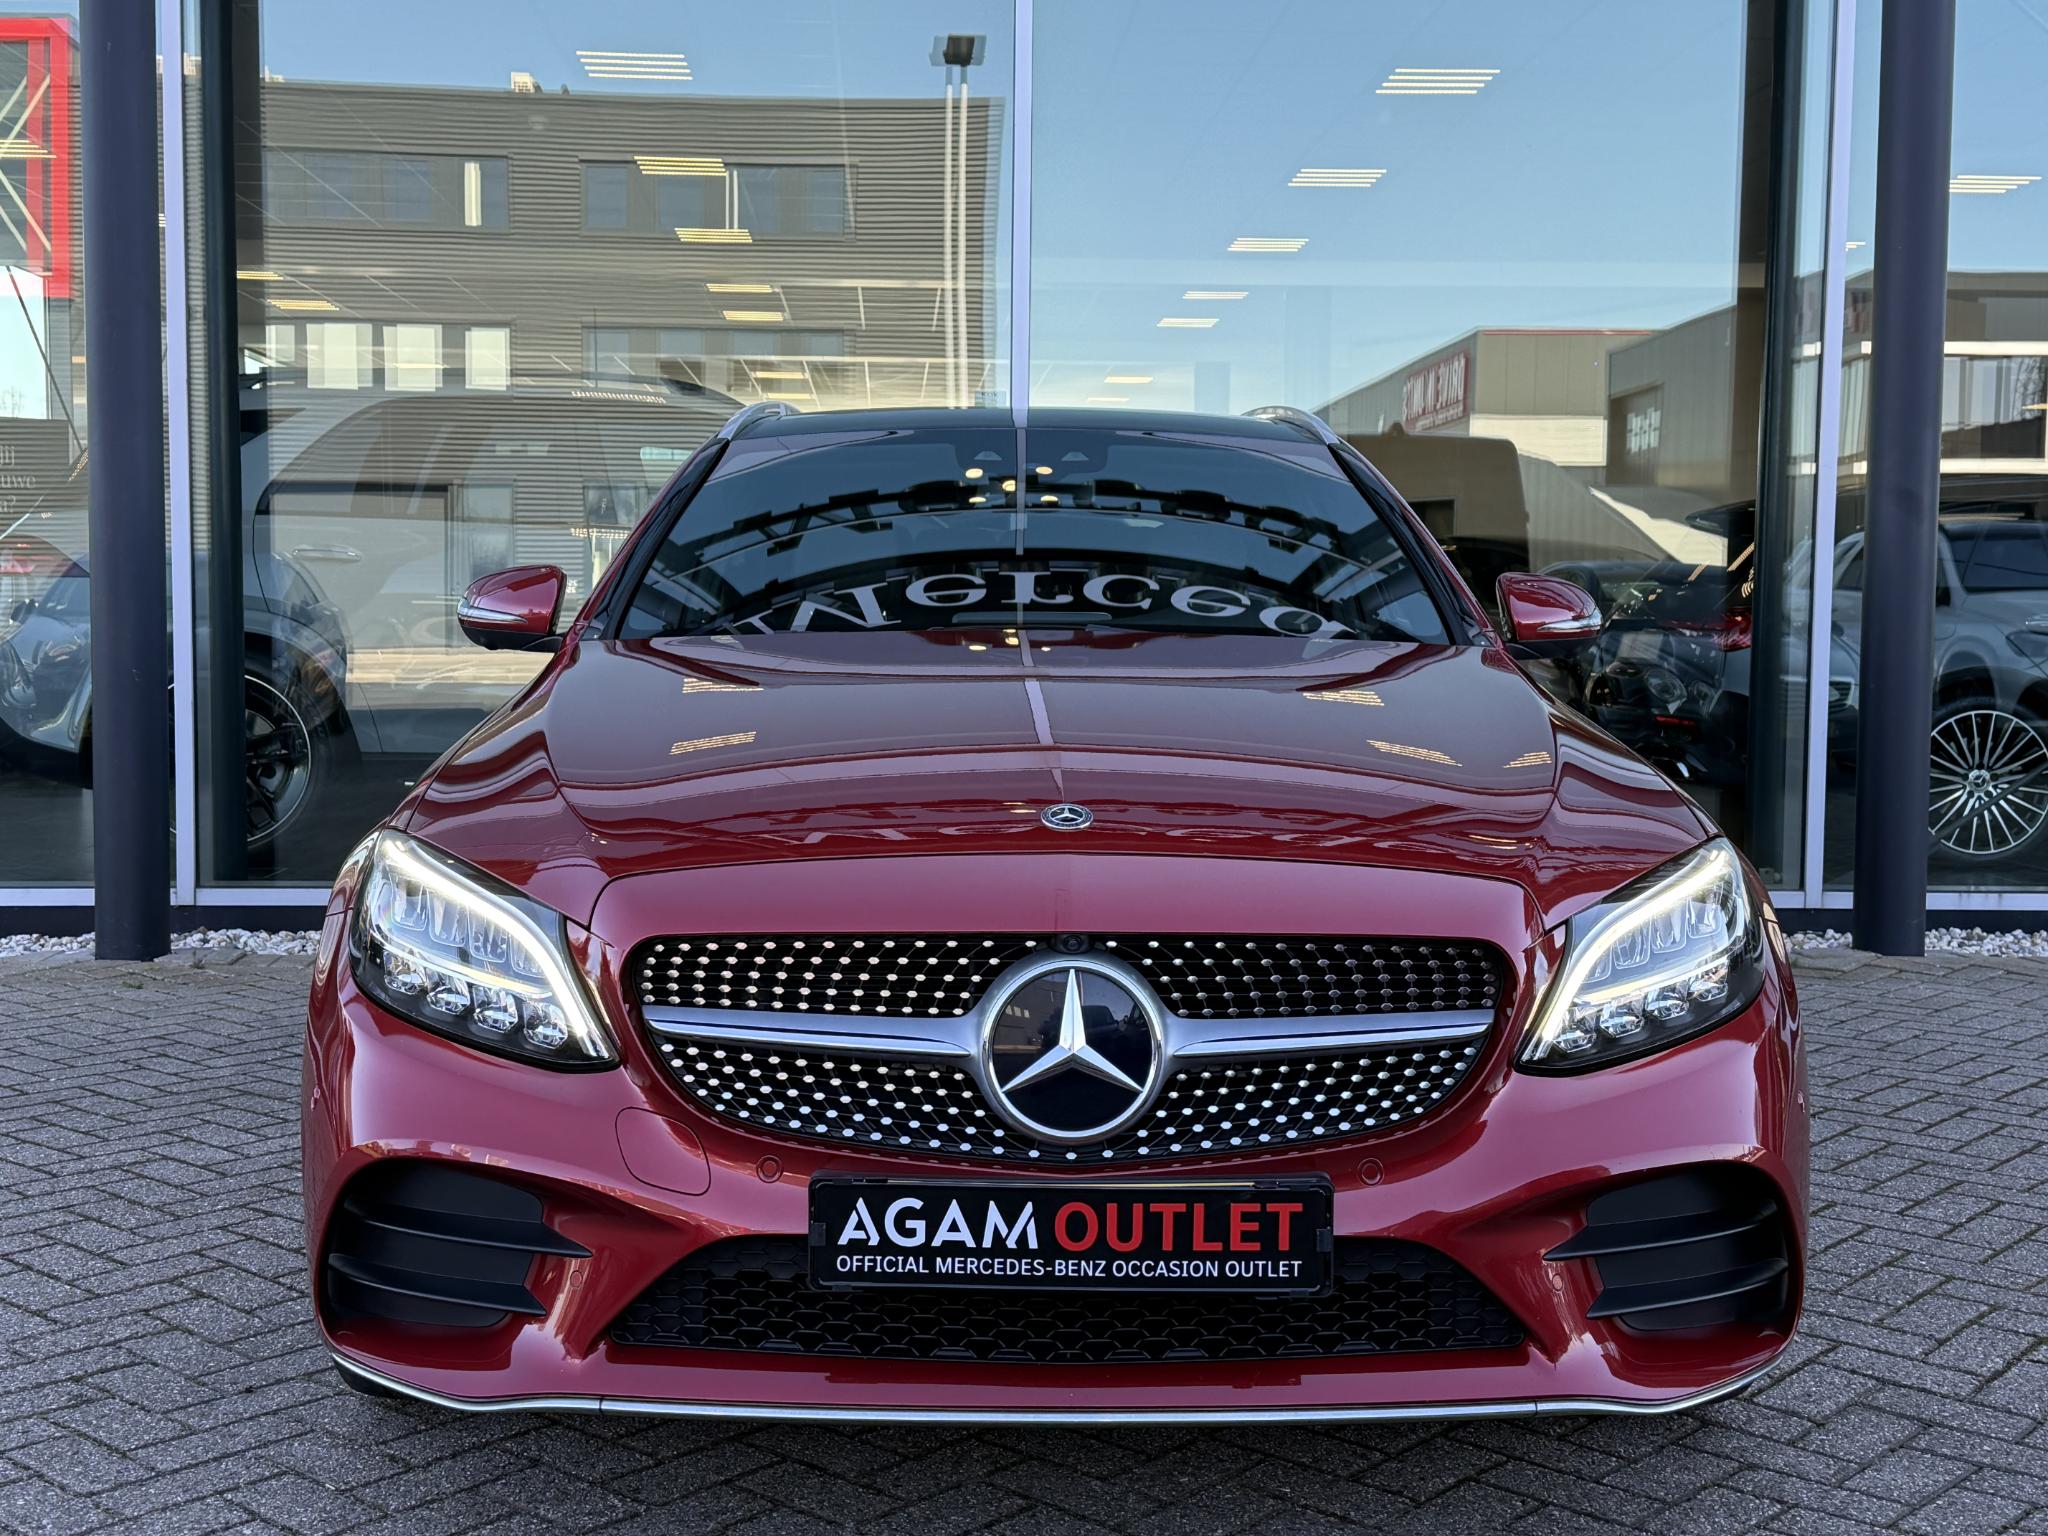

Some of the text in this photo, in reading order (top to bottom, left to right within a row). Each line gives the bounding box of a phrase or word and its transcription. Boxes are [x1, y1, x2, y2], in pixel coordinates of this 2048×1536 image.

[837, 1197, 1303, 1251] AGAM OUTLET
[836, 1255, 1303, 1278] OFFICIAL MERCEDES-BENZ OCCASION OUTLET
